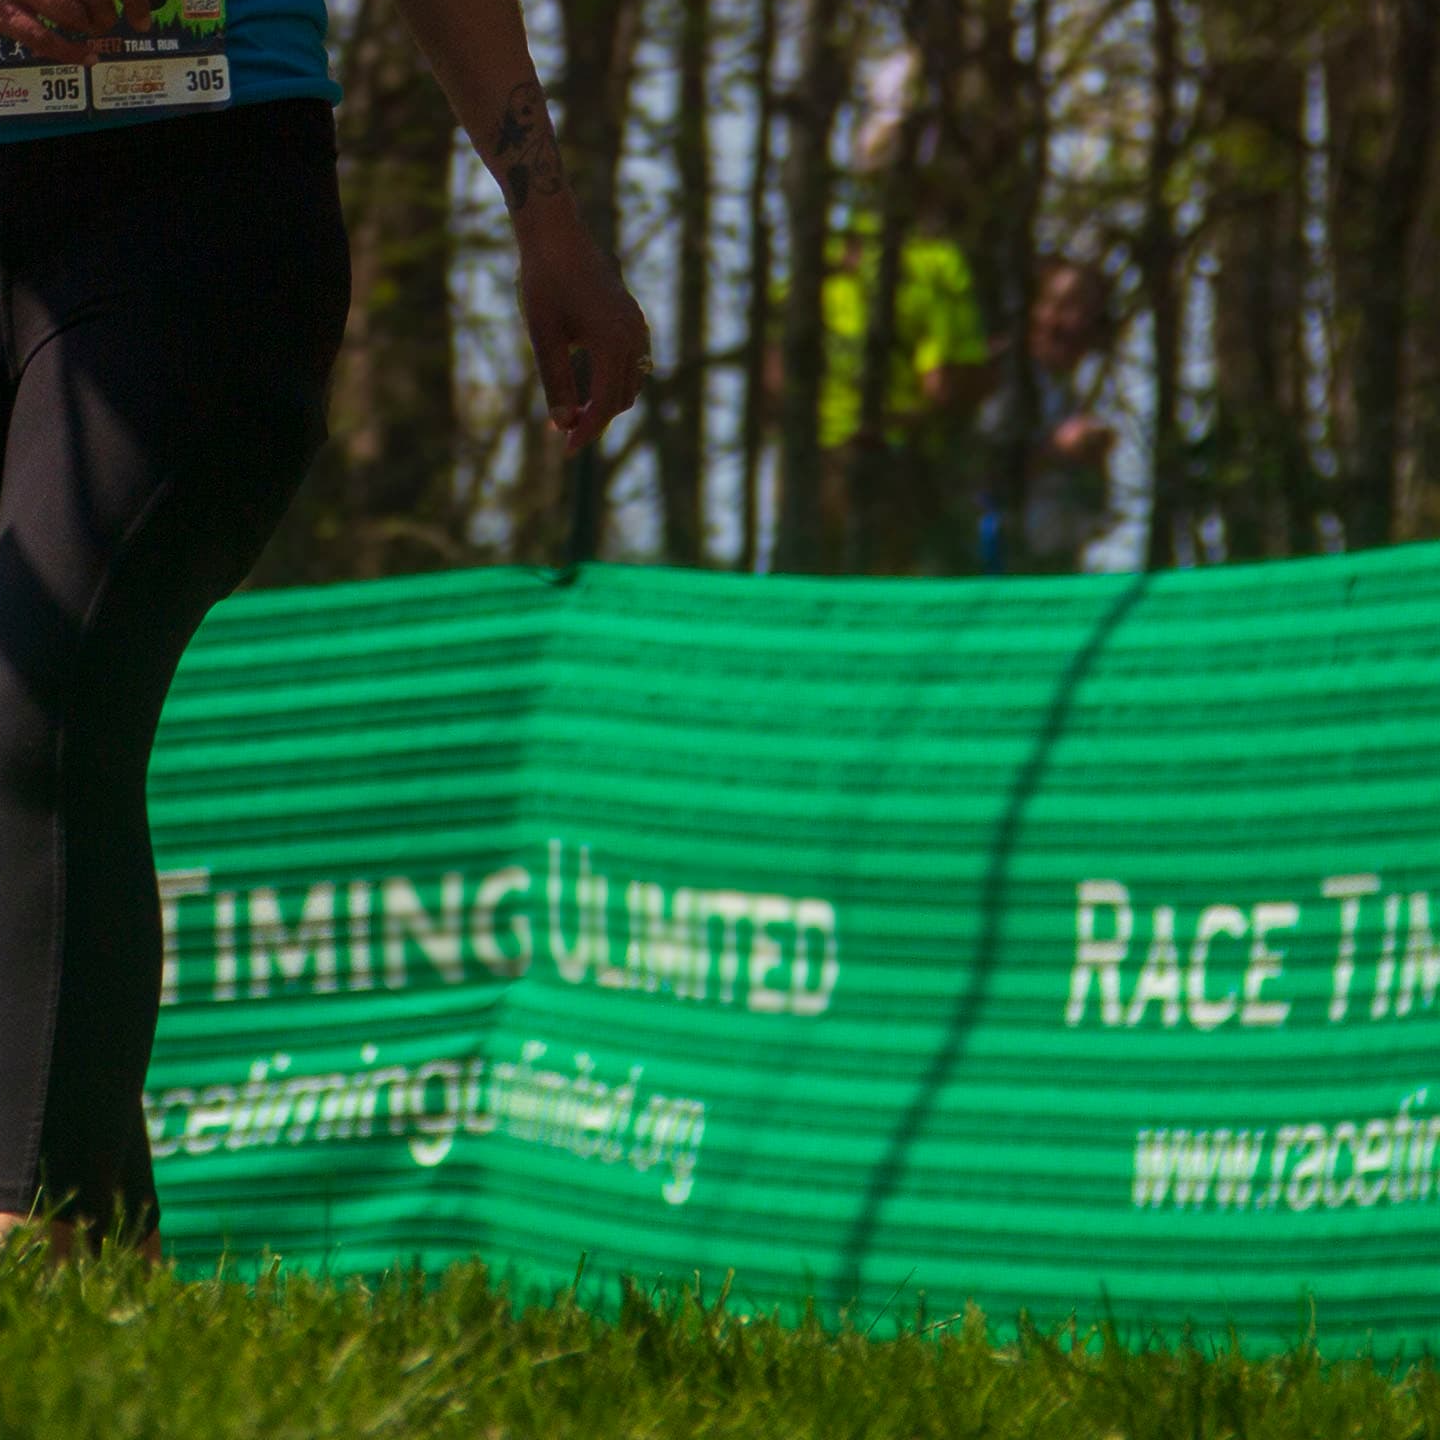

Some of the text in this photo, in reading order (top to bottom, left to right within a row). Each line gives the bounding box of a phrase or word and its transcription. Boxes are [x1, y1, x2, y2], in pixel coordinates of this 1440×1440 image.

[124, 39, 155, 52] TRAIL
[157, 38, 179, 51] RUN
[42, 78, 79, 101] 305
[186, 69, 224, 92] 305
[158, 866, 533, 1005] TIMING
[1065, 879, 1300, 1030] RACE
